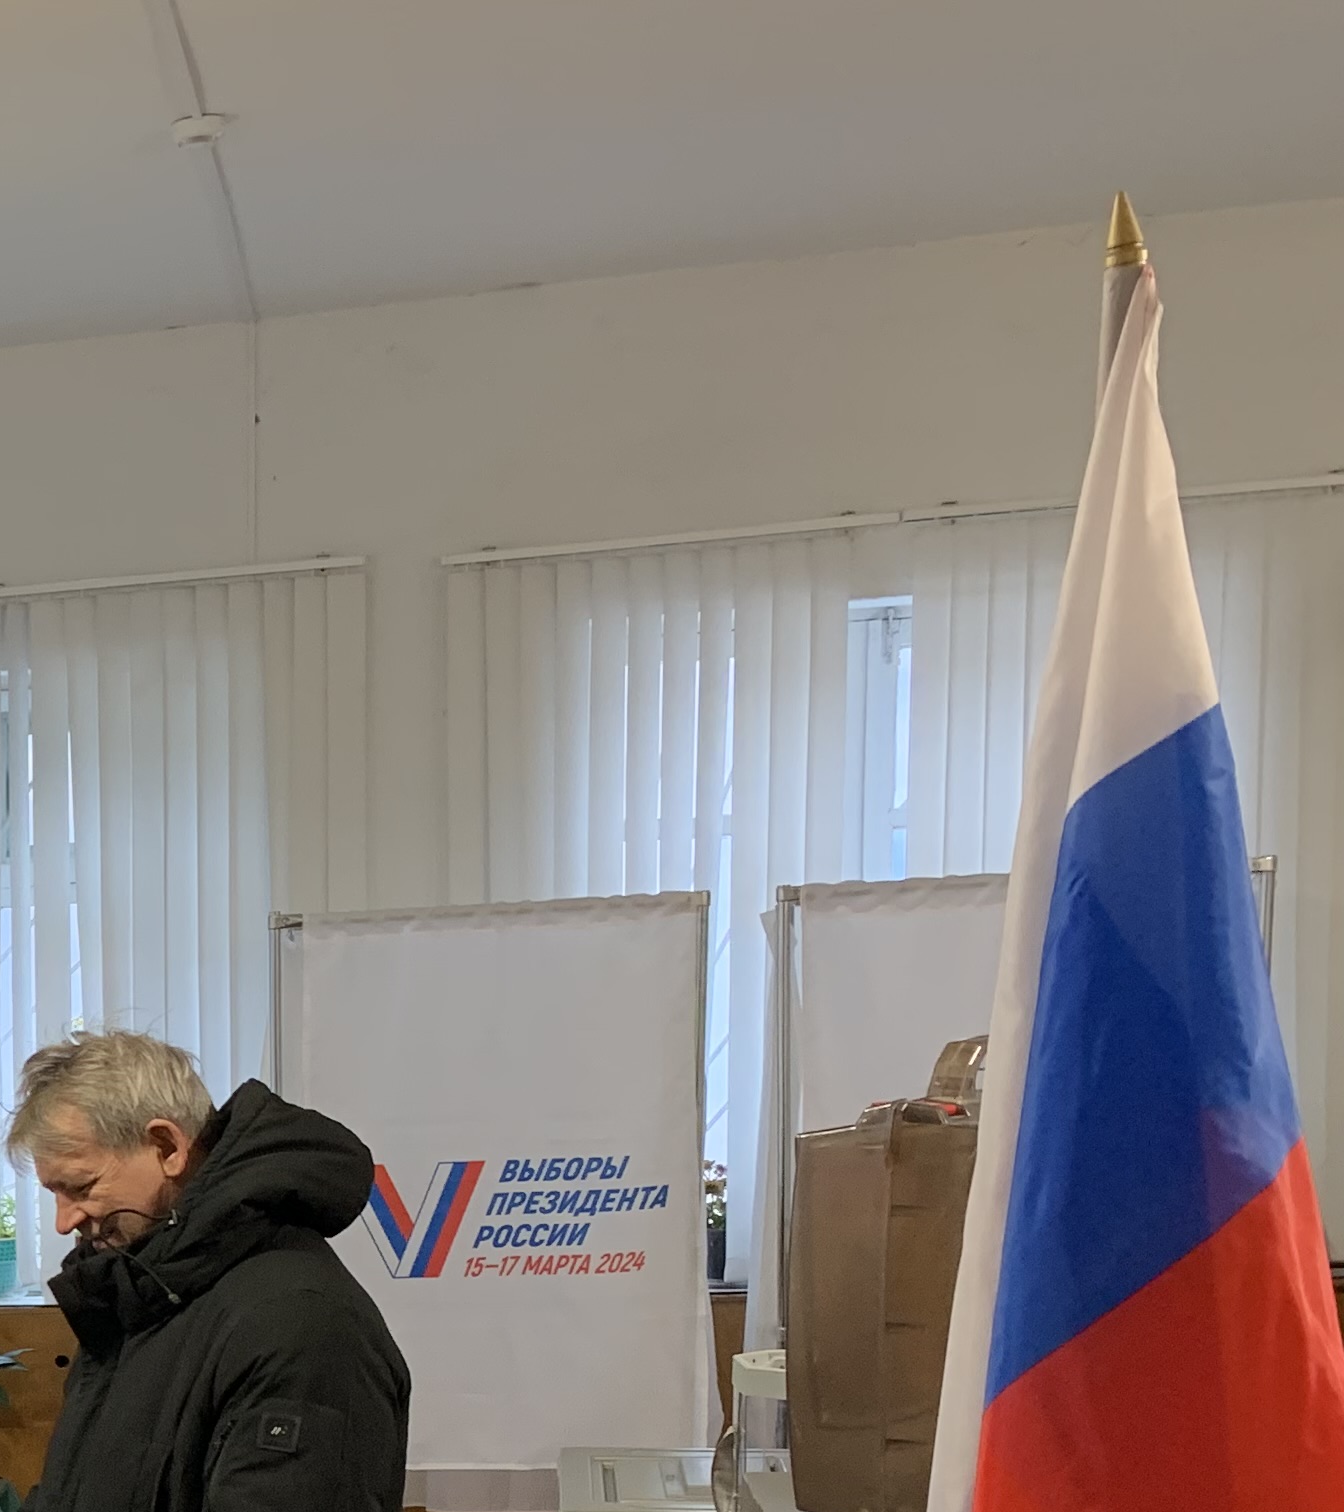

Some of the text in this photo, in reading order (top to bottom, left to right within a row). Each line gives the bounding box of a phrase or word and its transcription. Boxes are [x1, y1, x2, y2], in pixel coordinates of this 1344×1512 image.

[499, 1156, 630, 1183] ВЫБОРЫ
[486, 1184, 669, 1217] ПРЕЗИДЕНТА
[472, 1222, 591, 1249] РОССИИ
[522, 1254, 591, 1275] МАРТА
[595, 1251, 646, 1274] 2024
